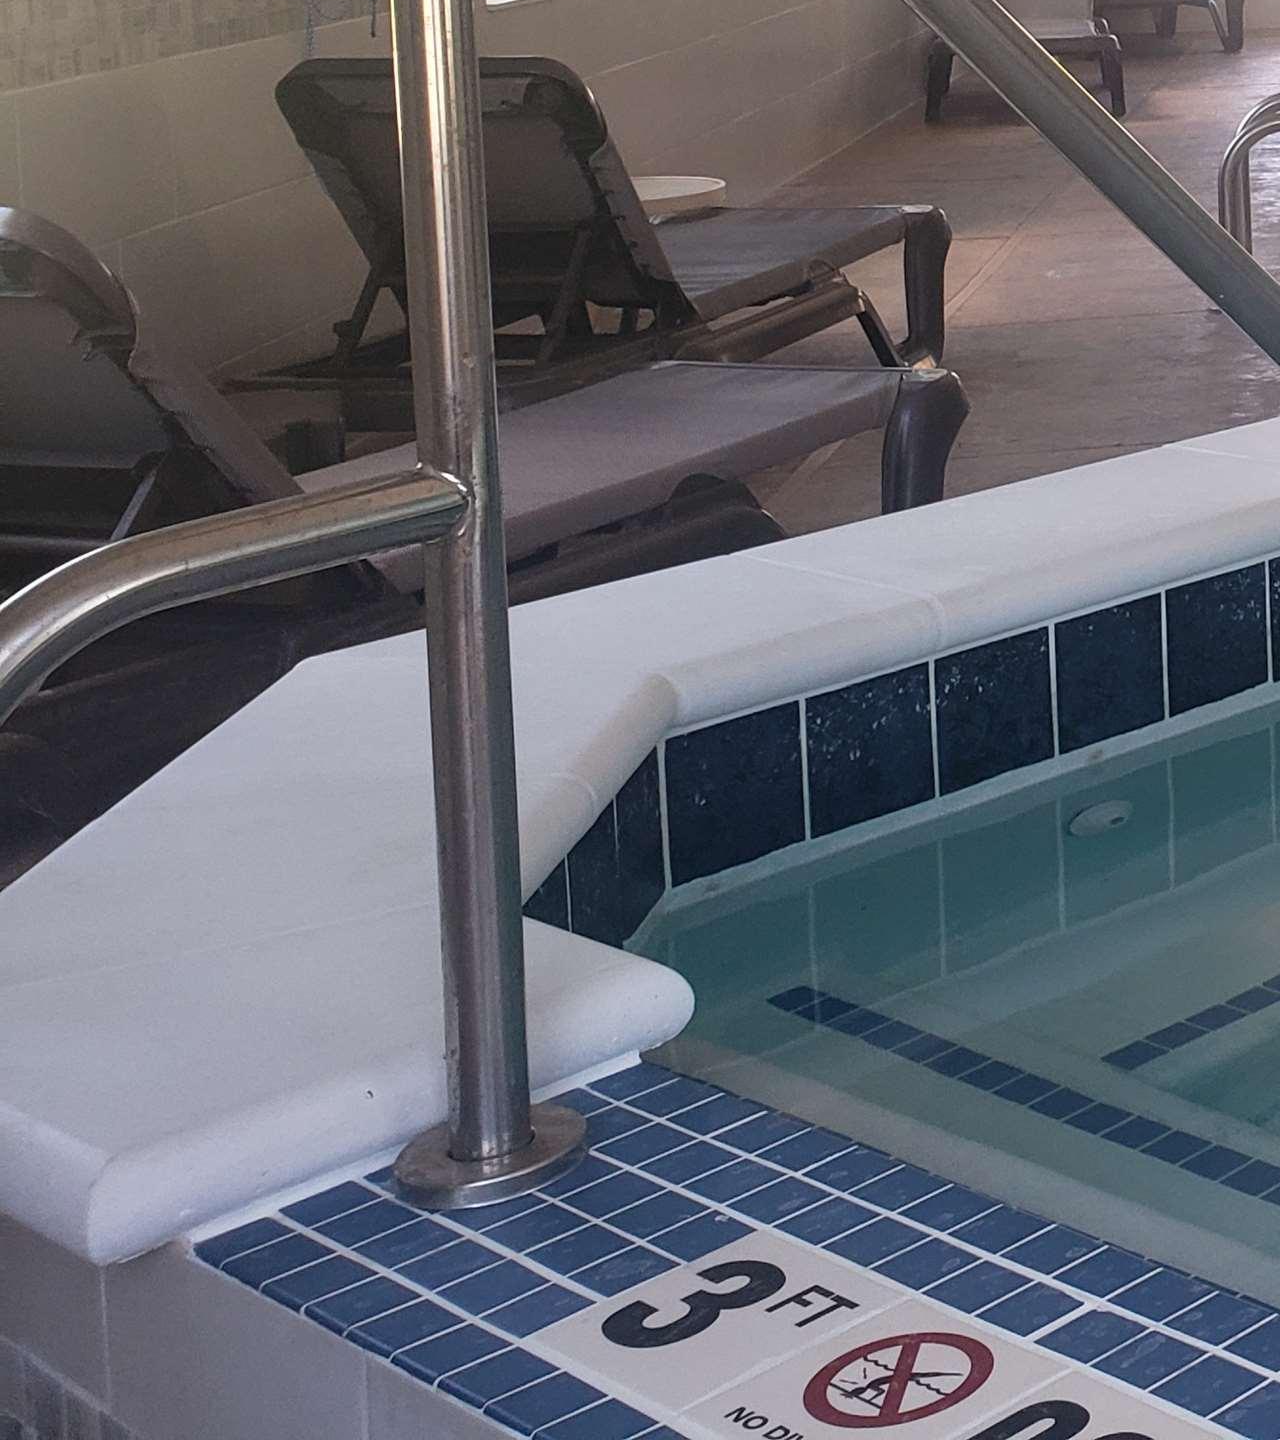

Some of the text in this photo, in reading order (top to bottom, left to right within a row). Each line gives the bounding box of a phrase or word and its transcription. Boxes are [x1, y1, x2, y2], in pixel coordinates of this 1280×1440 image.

[600, 1260, 860, 1348] 3 FT
[724, 1406, 769, 1430] NO
